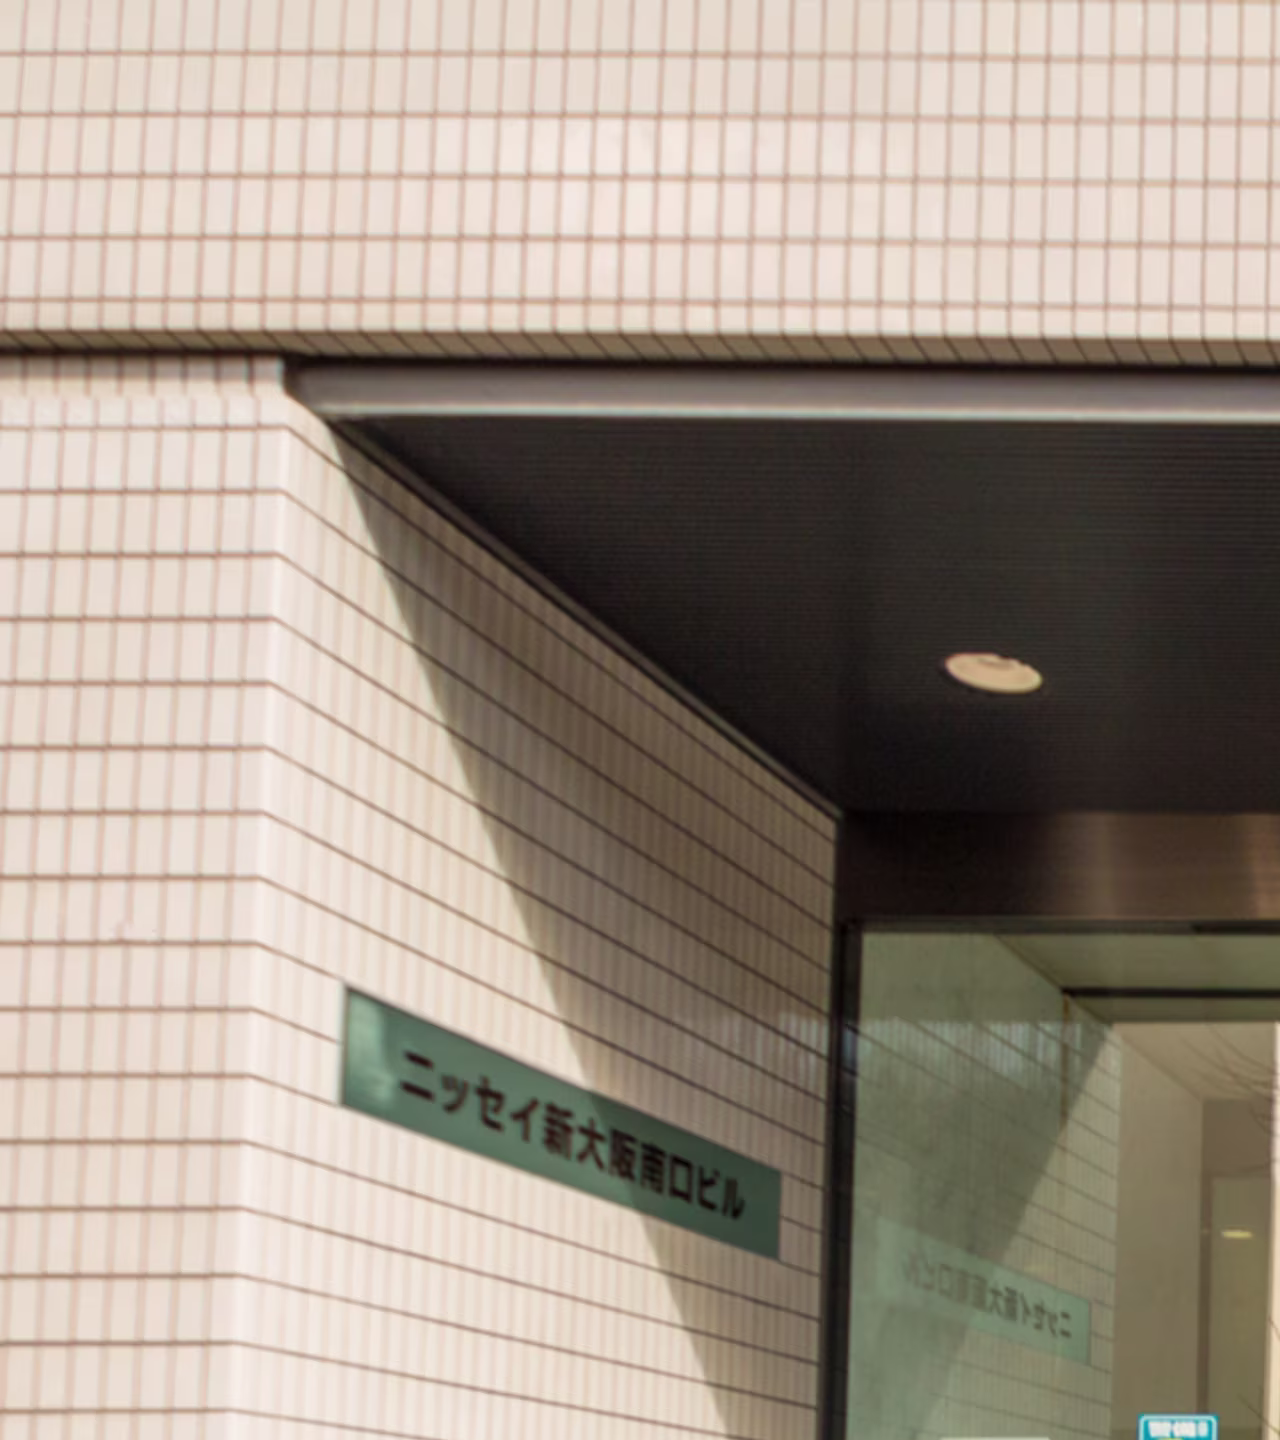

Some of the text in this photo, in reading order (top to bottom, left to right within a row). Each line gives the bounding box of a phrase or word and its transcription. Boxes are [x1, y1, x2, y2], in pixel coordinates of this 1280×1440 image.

[401, 1051, 746, 1222] ニッセイ新大阪南口ビル
